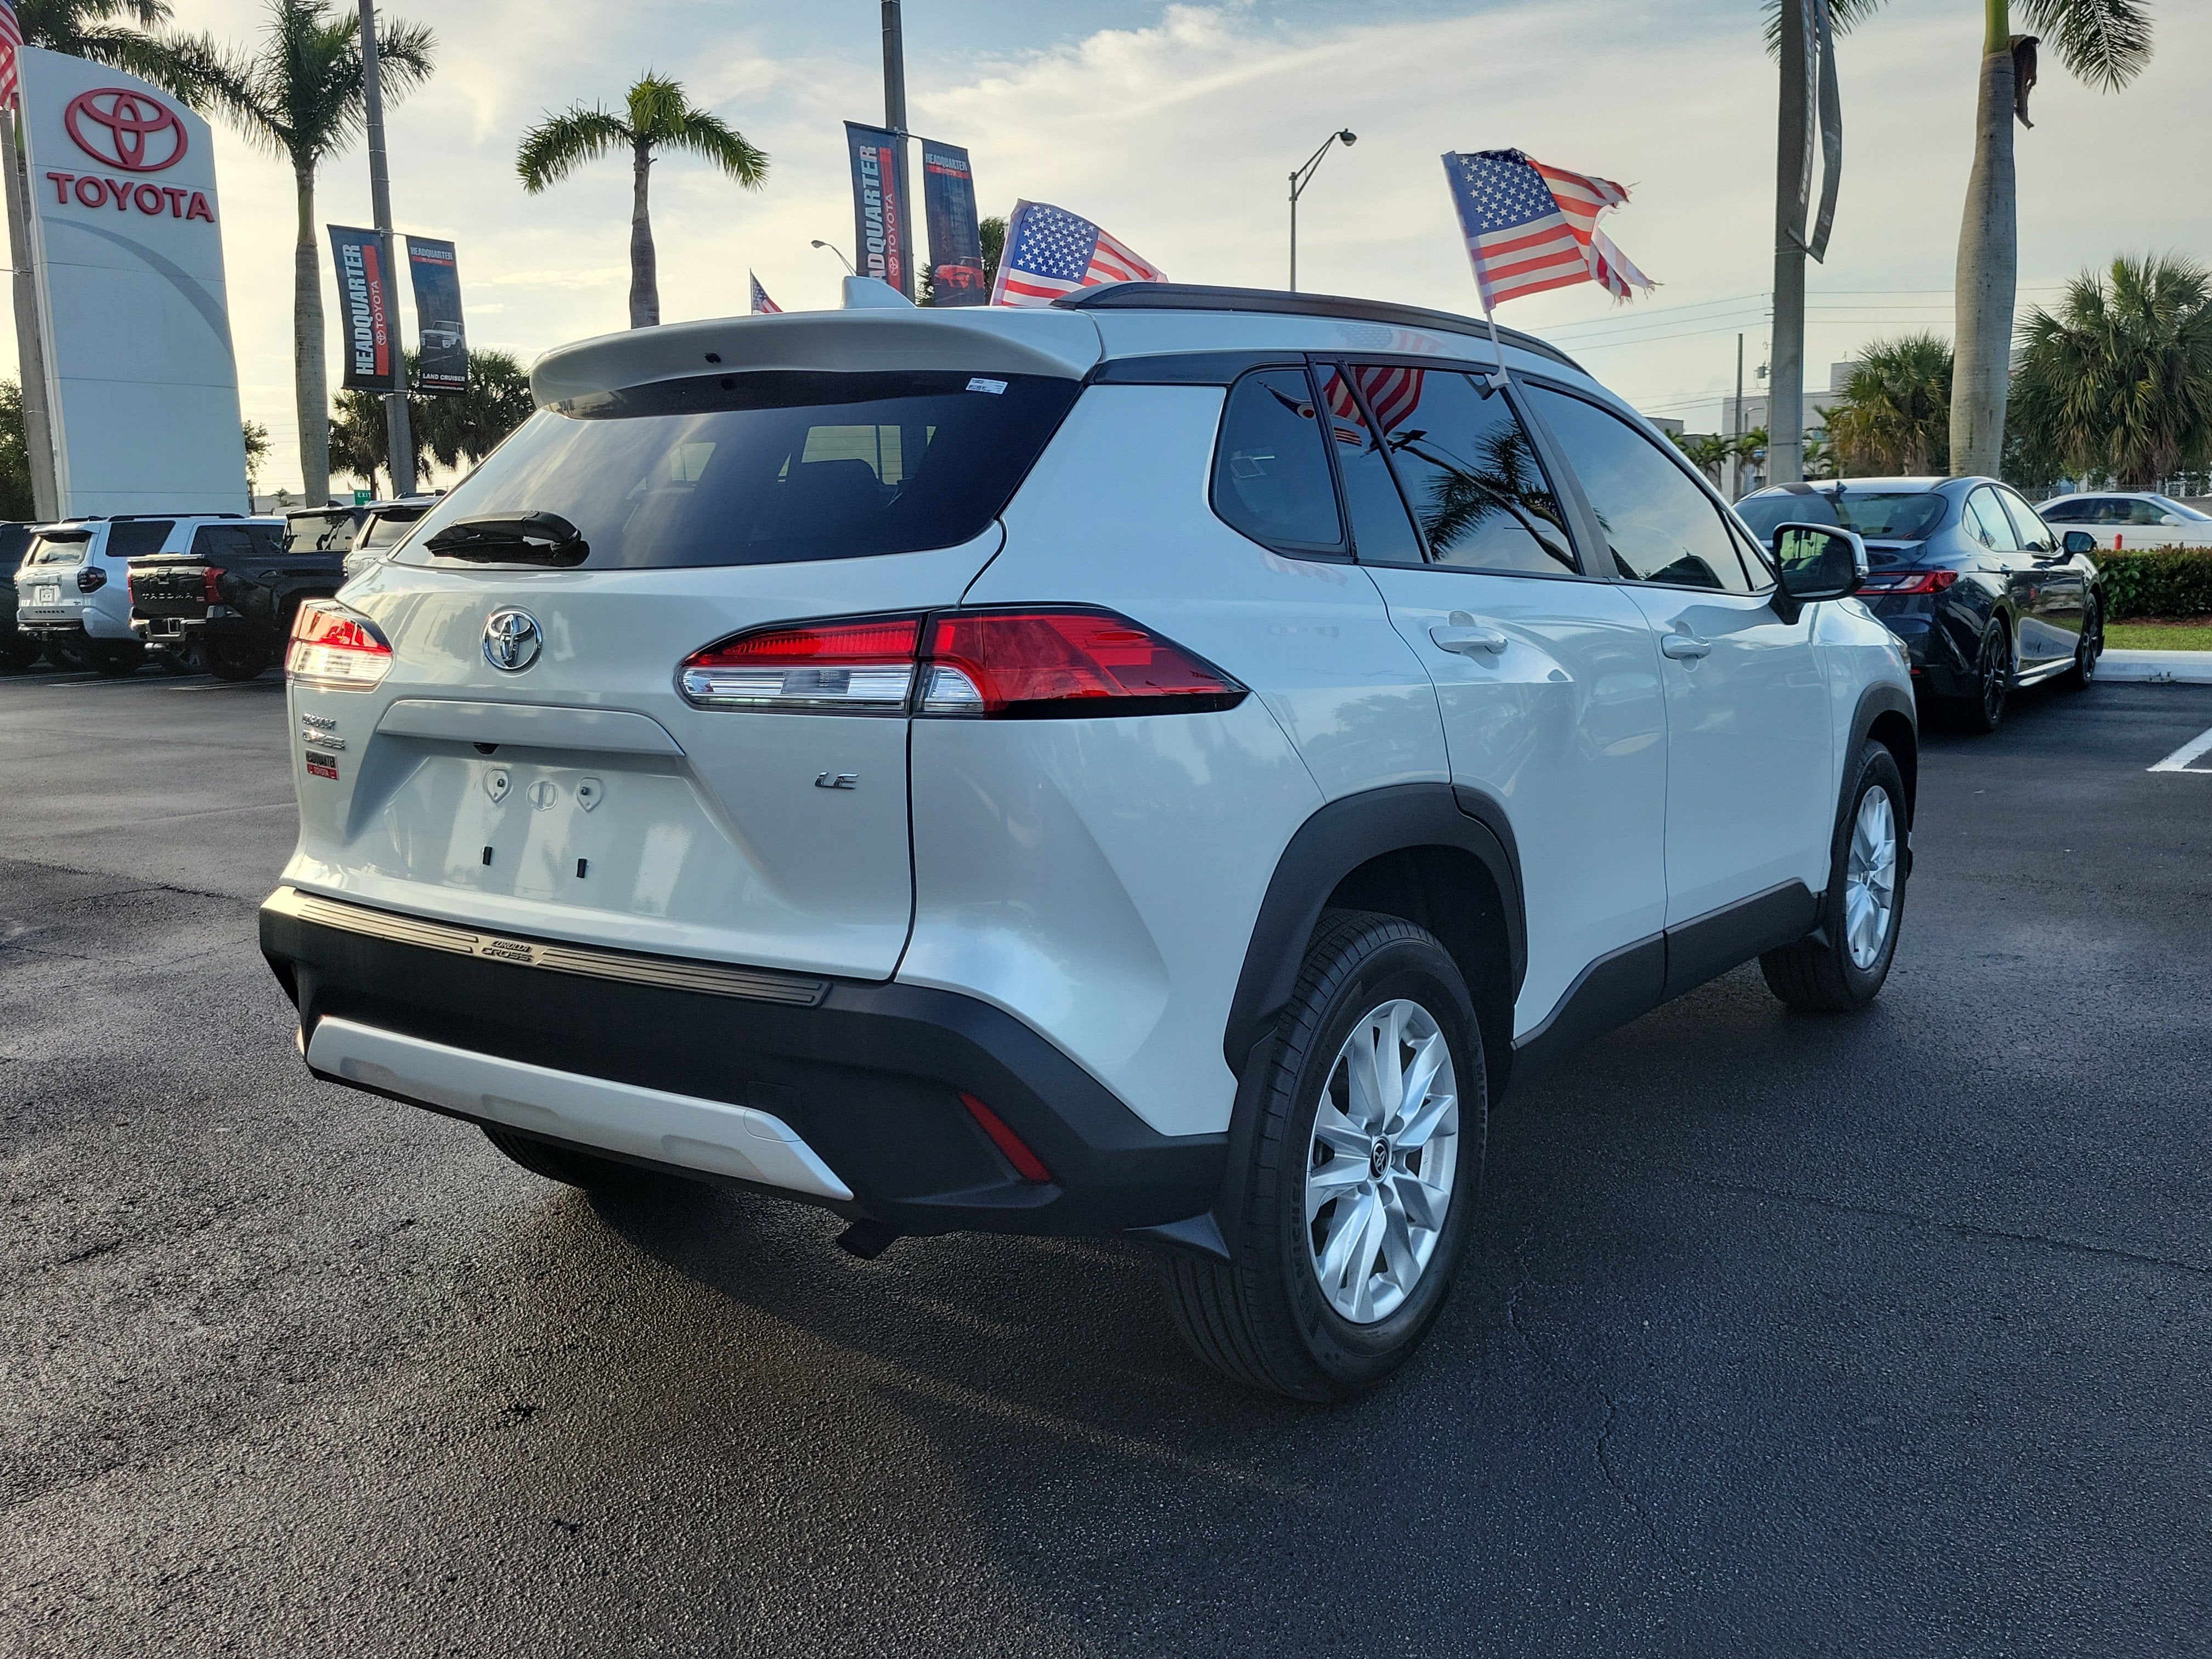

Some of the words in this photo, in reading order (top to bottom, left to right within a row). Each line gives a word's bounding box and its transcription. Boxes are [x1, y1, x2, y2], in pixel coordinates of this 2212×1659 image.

[926, 153, 967, 171] HEADQUARTER
[47, 172, 215, 223] TOYOTA
[860, 145, 887, 283] ADQUARTER
[885, 193, 897, 256] TOYOTA
[410, 247, 453, 260] HEADQUARTER
[342, 244, 374, 375] HEADQUARTER
[371, 280, 385, 329] TOYOTA
[815, 771, 859, 789] LE
[482, 947, 533, 962] CROSS
[491, 940, 531, 953] COROLLA
